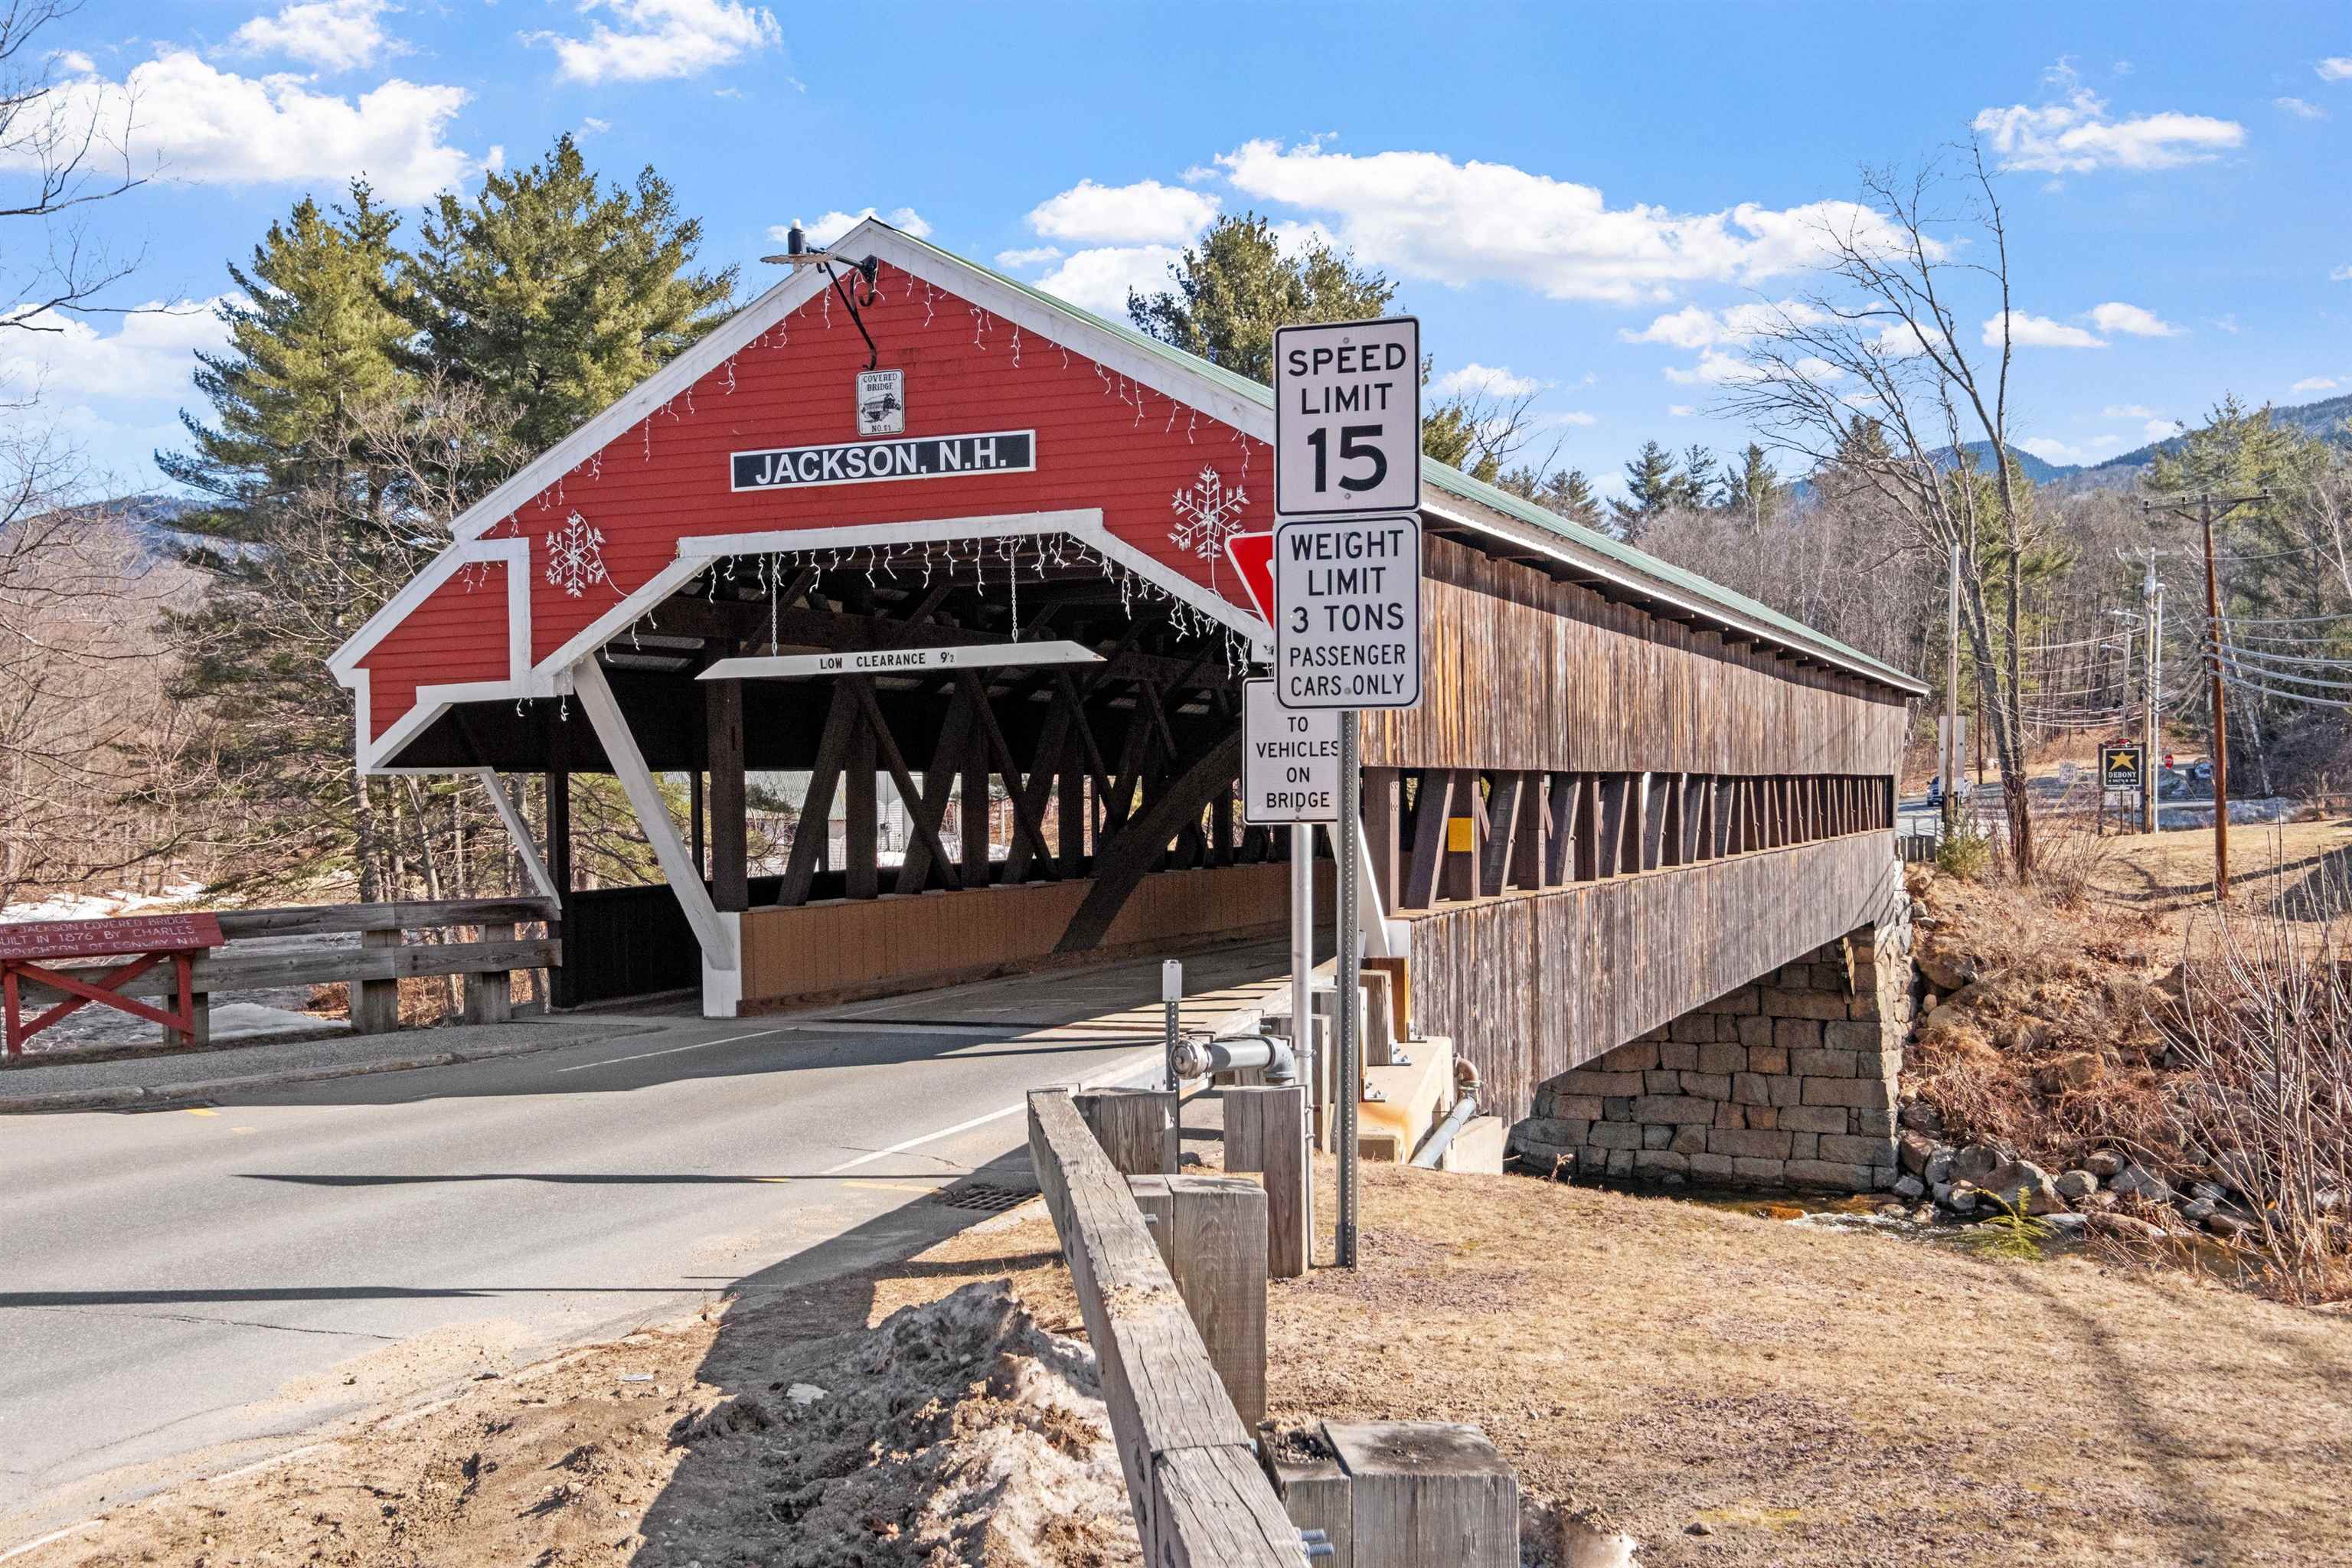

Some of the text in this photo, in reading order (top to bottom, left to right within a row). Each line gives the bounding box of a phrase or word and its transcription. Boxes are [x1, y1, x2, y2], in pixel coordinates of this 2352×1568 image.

[1288, 342, 1406, 377] SPEED
[864, 374, 897, 383] COVERED
[867, 383, 893, 391] BRIDGE
[1302, 383, 1393, 415] LIMIT
[756, 438, 1006, 485] JACKSON, N.H.
[1307, 424, 1387, 493] 15
[1291, 529, 1403, 561] WEIGHT
[1308, 567, 1386, 596] LIMIT
[1292, 602, 1403, 633] 3 TONS
[820, 658, 842, 669] LOW
[857, 652, 925, 667] CLEARANCE
[1289, 644, 1406, 668] PASSENGER
[1291, 674, 1404, 697] CARS ONLY
[1287, 717, 1308, 732] TO
[1256, 741, 1338, 758] VEHICLES
[1286, 767, 1309, 782] ON
[1266, 792, 1329, 808] BRIDGE
[84, 920, 142, 930] COVERED
[149, 916, 191, 926] BRIDGE
[59, 933, 93, 942] 1876
[134, 926, 194, 937] CHARLES
